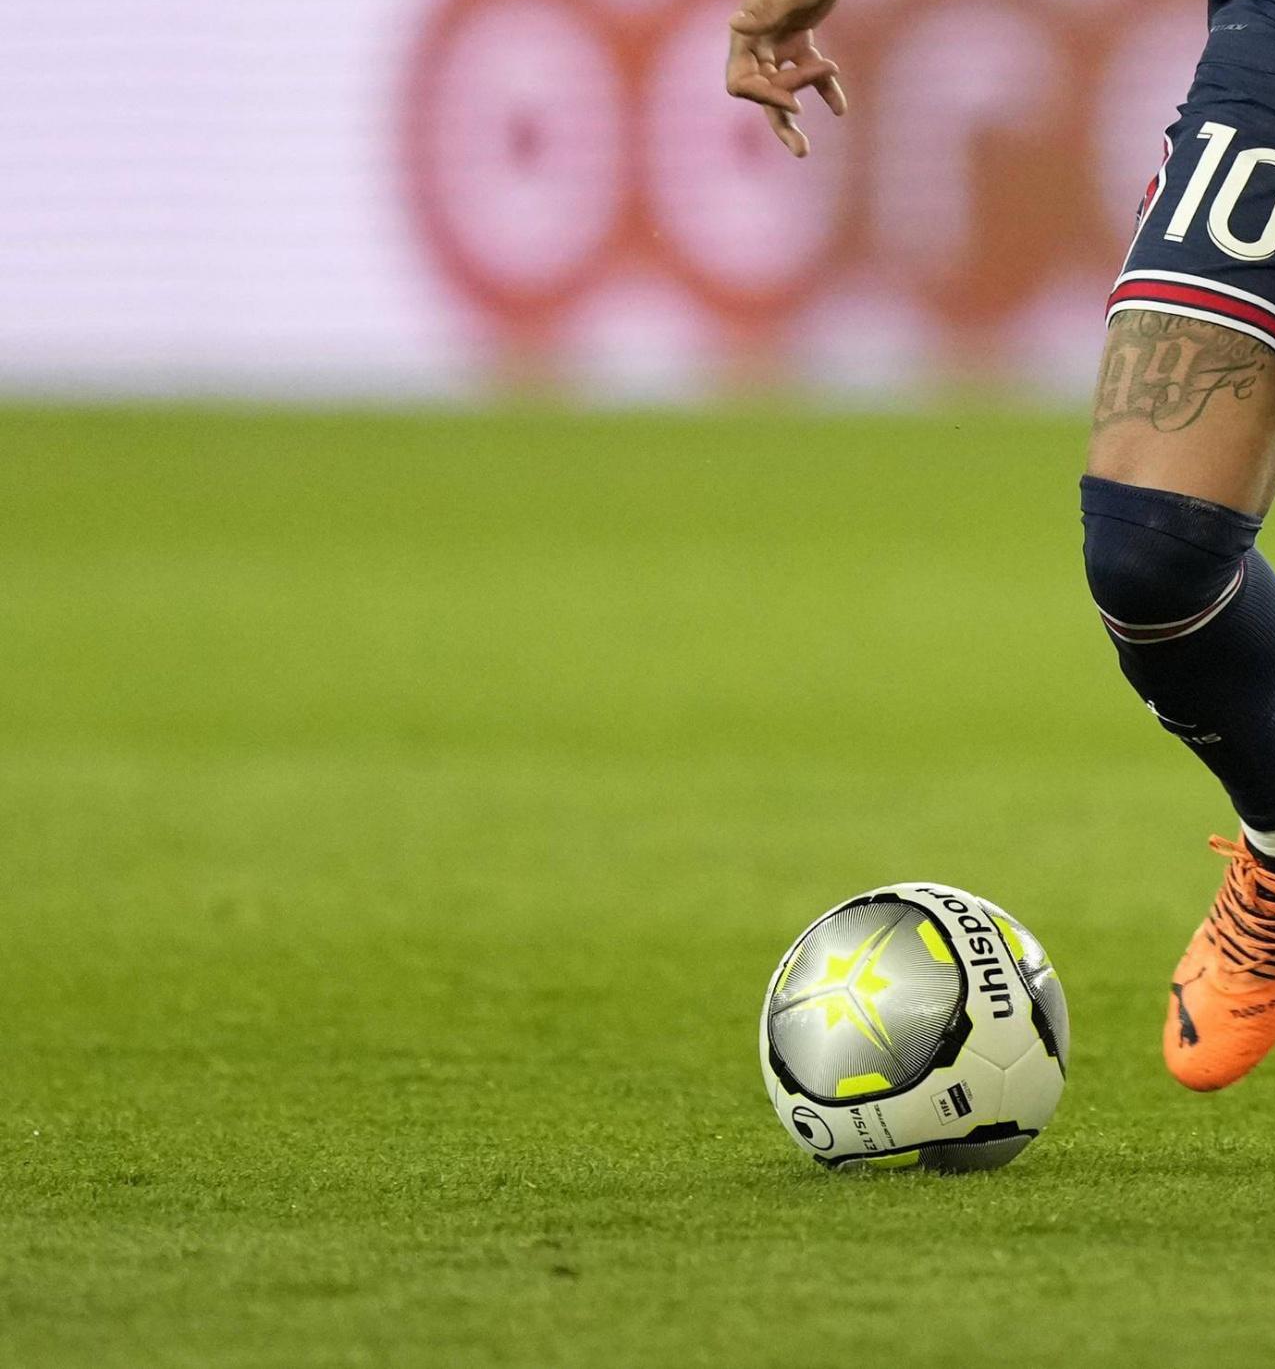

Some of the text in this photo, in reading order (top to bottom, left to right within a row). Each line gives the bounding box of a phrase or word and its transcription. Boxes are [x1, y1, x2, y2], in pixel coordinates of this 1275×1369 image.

[915, 887, 1014, 1019] uhlsport
[850, 1107, 878, 1151] ELYSIA
[938, 1098, 952, 1117] FIFA
